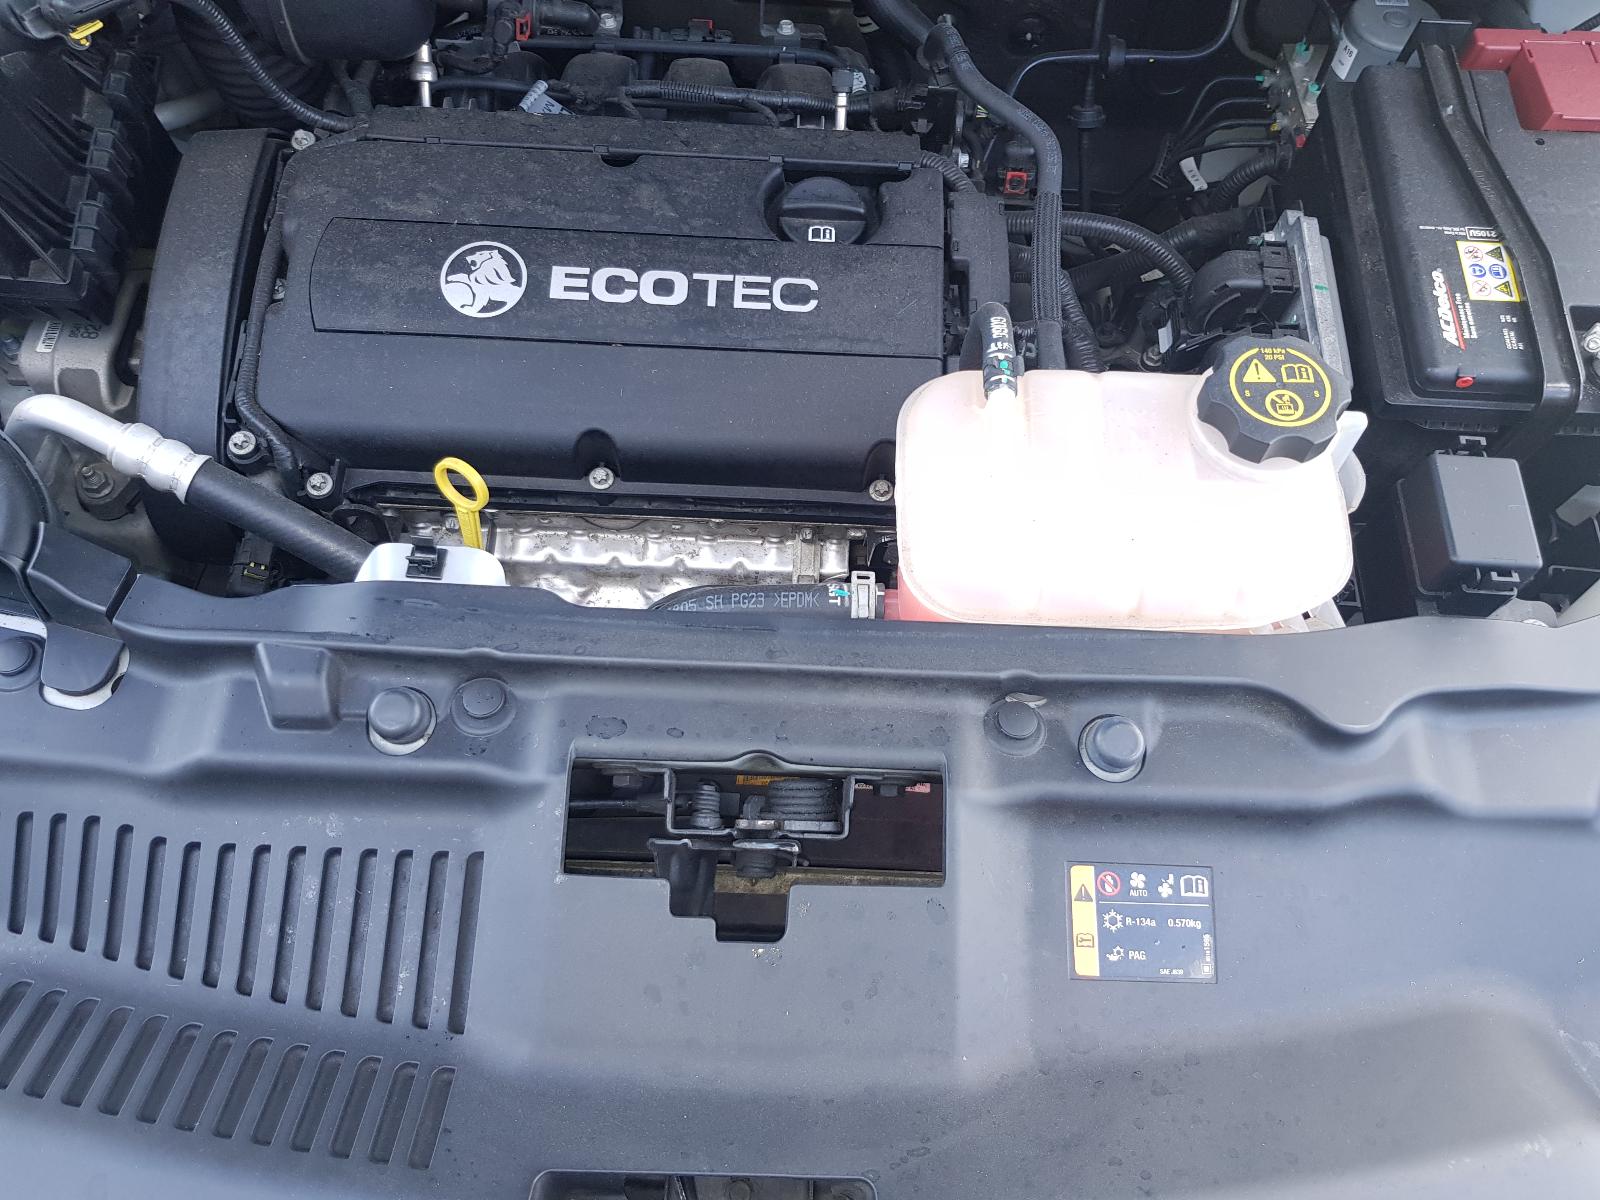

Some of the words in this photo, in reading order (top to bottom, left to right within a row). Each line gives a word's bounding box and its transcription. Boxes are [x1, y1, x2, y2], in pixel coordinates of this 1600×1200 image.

[549, 265, 820, 313] ECOTEC
[705, 594, 723, 610] SH
[731, 592, 765, 608] PG23
[1129, 889, 1148, 897] AUTO
[1125, 917, 1157, 928] R-134a
[1167, 918, 1202, 929] 0.570kg
[1128, 950, 1147, 961] PAG
